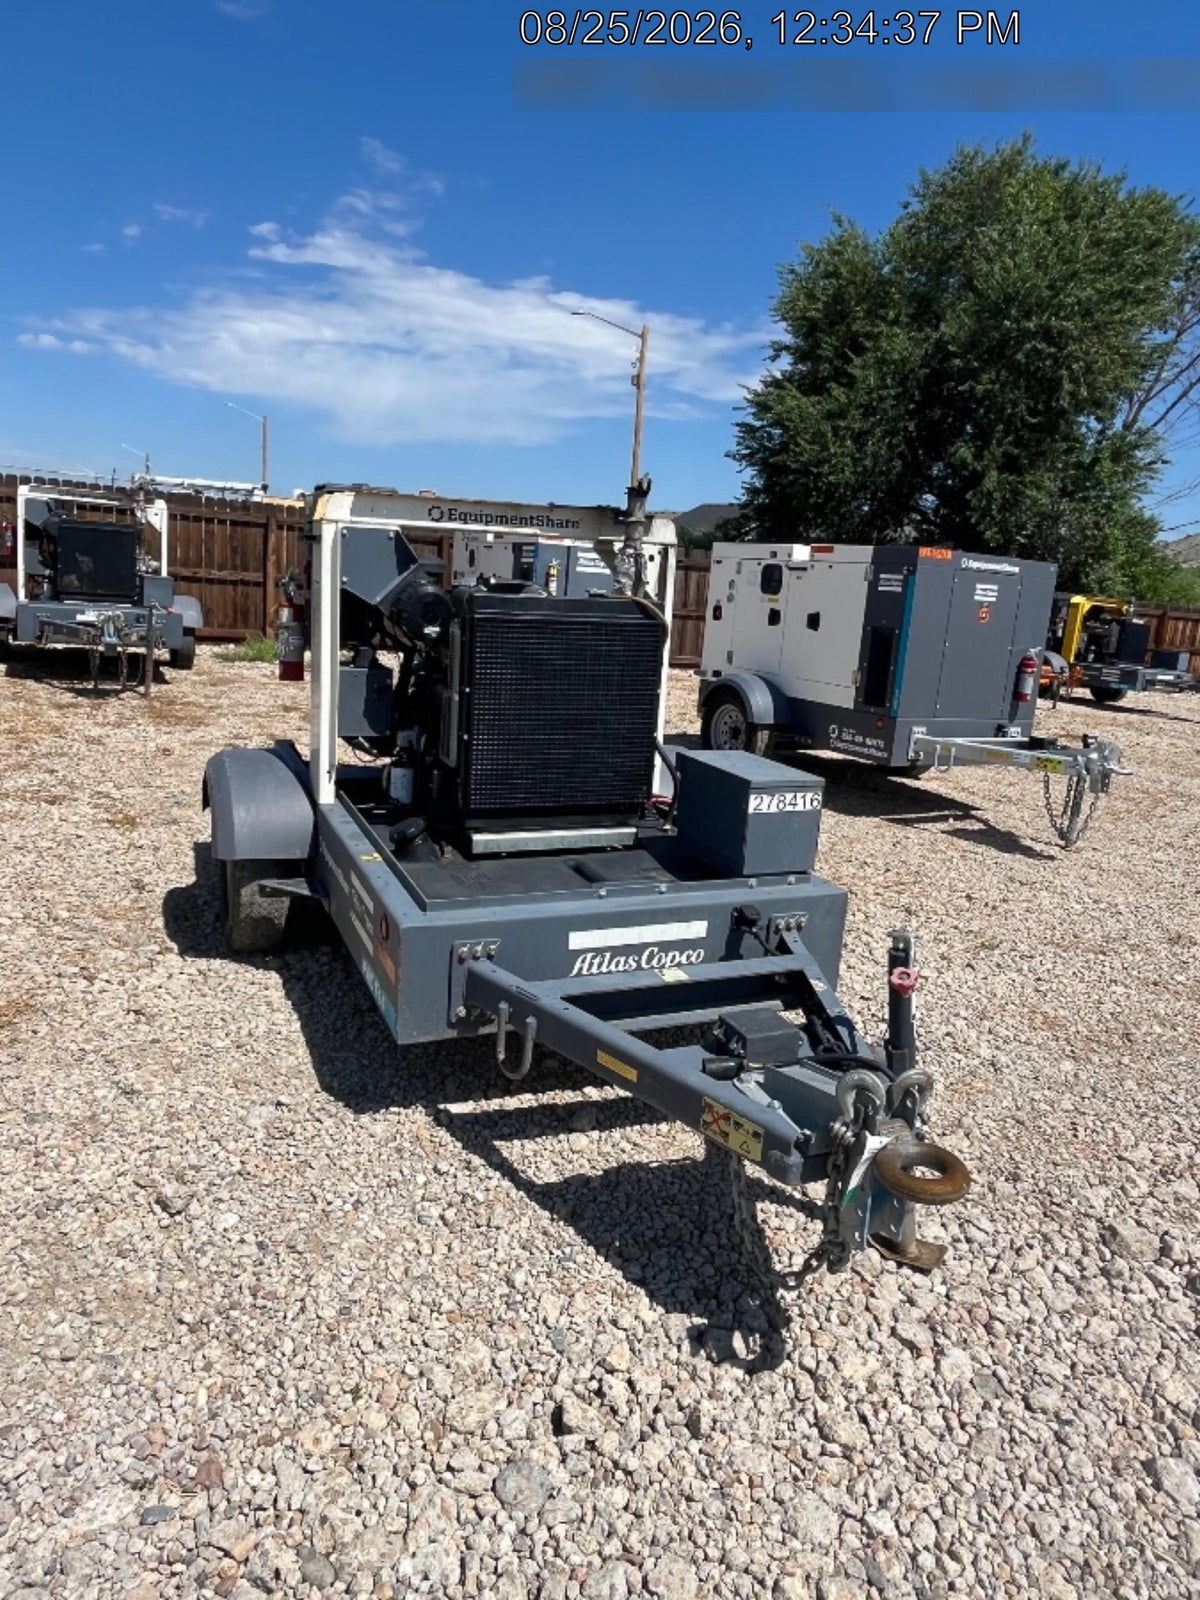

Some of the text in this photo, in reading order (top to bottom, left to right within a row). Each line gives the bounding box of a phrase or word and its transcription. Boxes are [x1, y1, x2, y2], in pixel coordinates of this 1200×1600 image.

[447, 507, 581, 529] EquipmentShare
[753, 792, 821, 812] 278416
[568, 946, 705, 977] Atlas Copco
